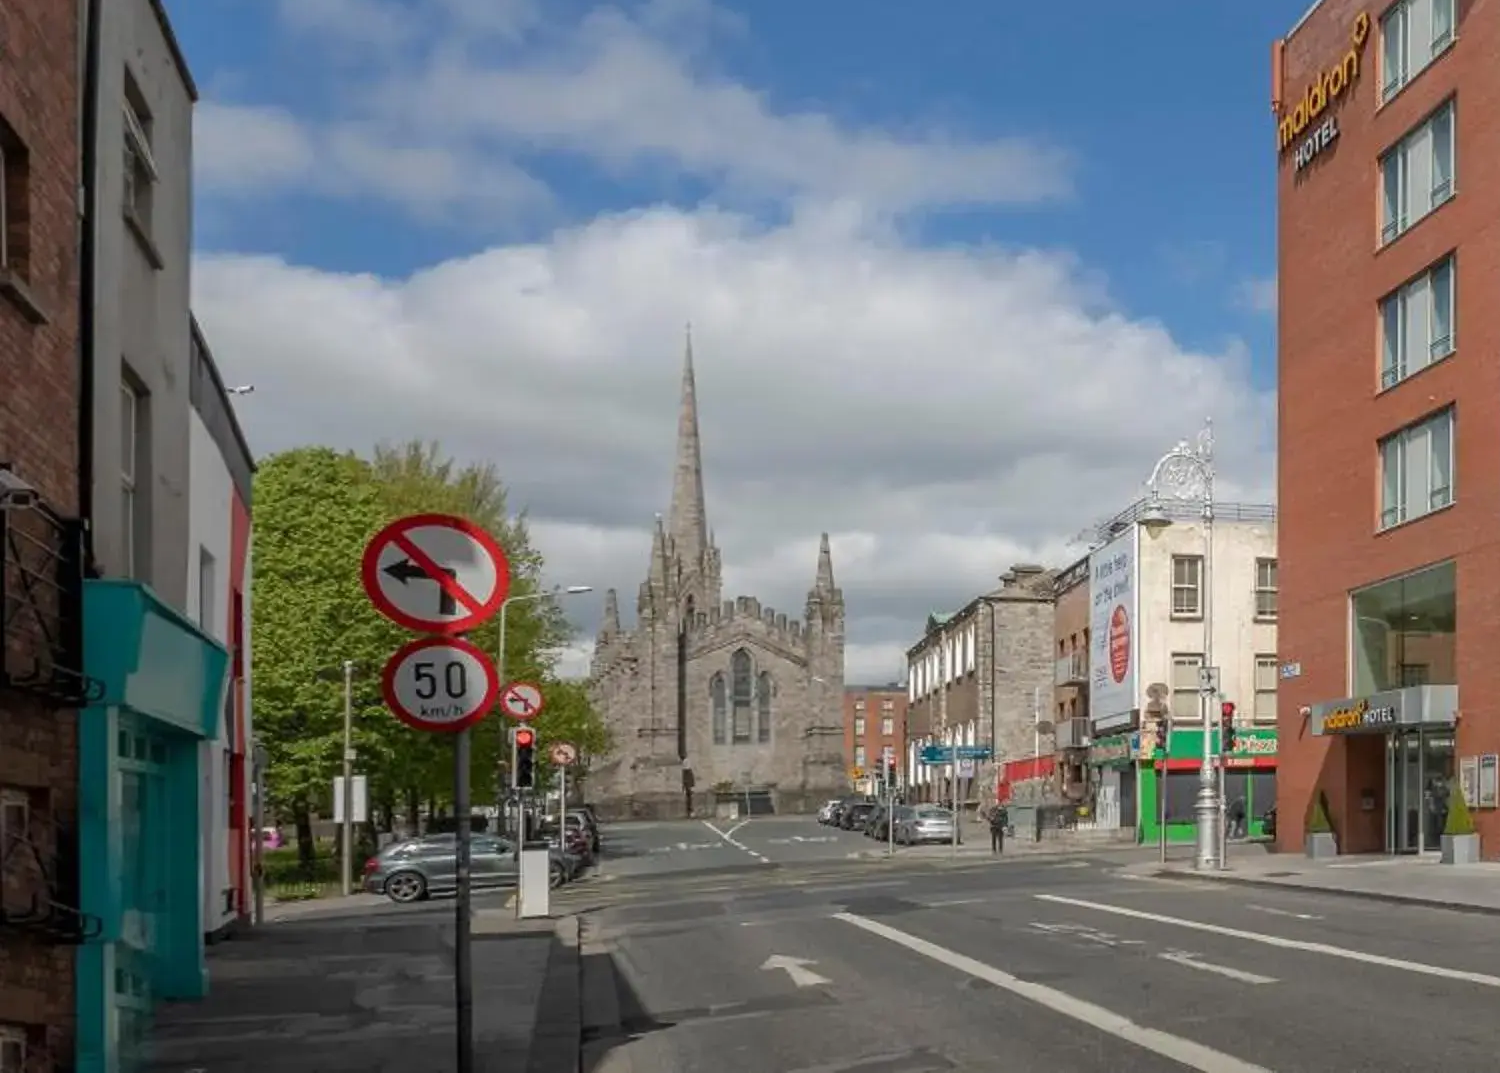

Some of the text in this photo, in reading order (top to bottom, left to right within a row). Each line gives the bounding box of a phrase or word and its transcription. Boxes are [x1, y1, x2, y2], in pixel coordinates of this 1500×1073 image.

[1278, 50, 1359, 151] maldron
[1294, 116, 1340, 171] HOTEL
[414, 661, 466, 699] 50
[420, 704, 463, 718] km/h
